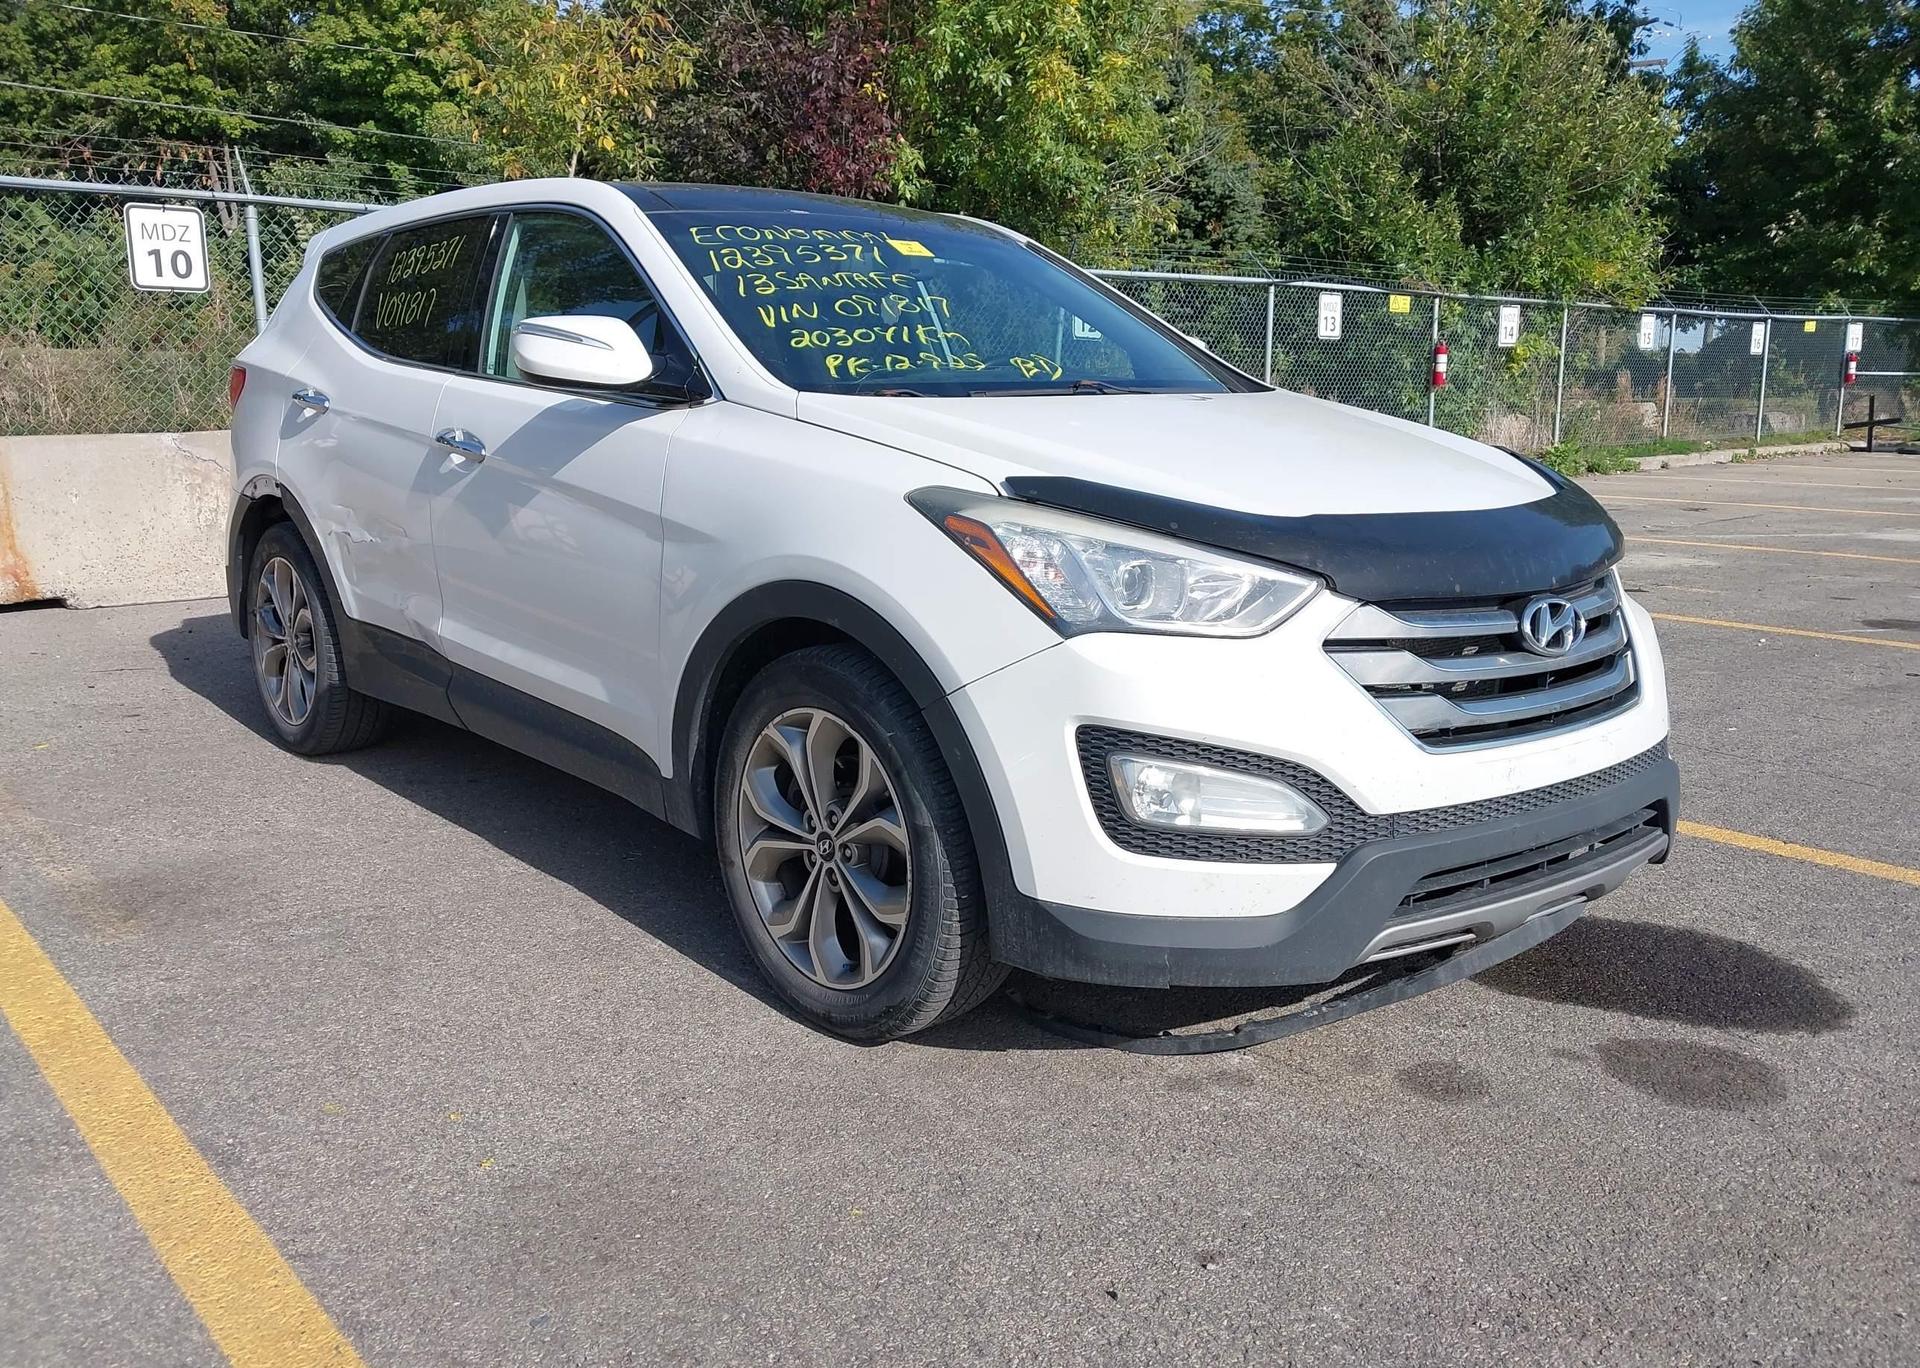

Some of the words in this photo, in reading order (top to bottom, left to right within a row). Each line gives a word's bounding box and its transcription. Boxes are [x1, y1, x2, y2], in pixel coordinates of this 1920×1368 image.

[141, 222, 191, 242] MDZ
[147, 249, 193, 279] 10
[386, 234, 467, 285] 12395371
[709, 243, 888, 272] 12395371
[376, 287, 437, 330] V091817
[757, 302, 818, 328] VIN
[834, 294, 950, 318] 091817
[1323, 301, 1339, 312] MDZ
[1323, 316, 1337, 332] 13
[1503, 326, 1514, 340] 14
[1643, 332, 1651, 345] 15
